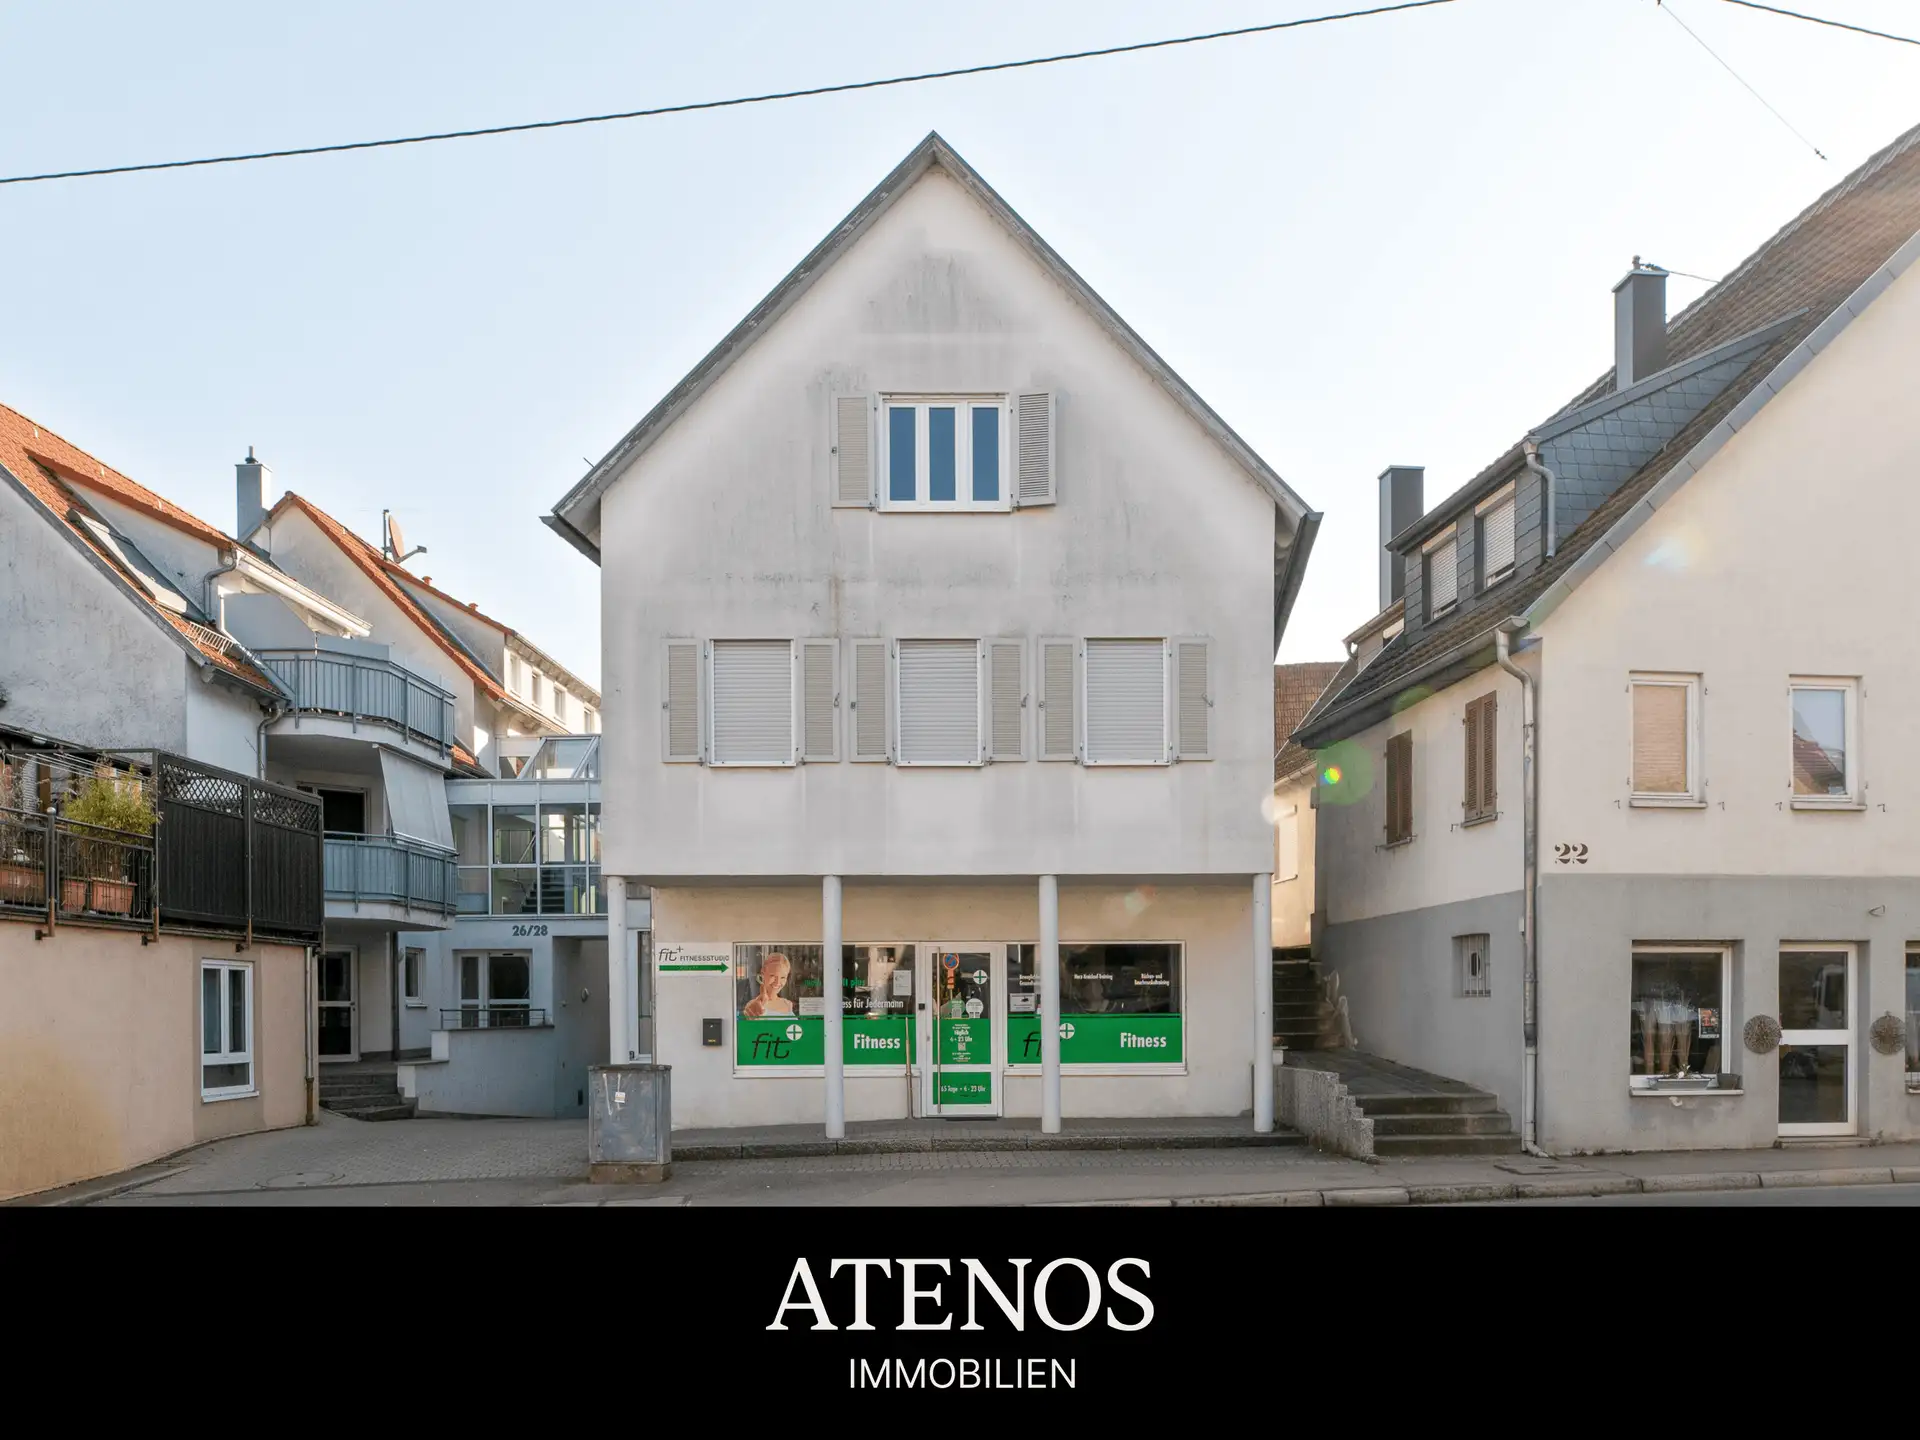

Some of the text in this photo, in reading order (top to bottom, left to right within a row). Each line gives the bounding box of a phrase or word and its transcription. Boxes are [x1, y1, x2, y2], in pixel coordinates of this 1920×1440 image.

[1554, 843, 1589, 865] 22
[511, 924, 549, 937] 26/28
[679, 954, 730, 962] FITNESSSTUDIO
[853, 997, 864, 1008] für
[865, 998, 904, 1008] Jedermann
[853, 1033, 901, 1050] Fitness
[1120, 1032, 1167, 1048] Fitness
